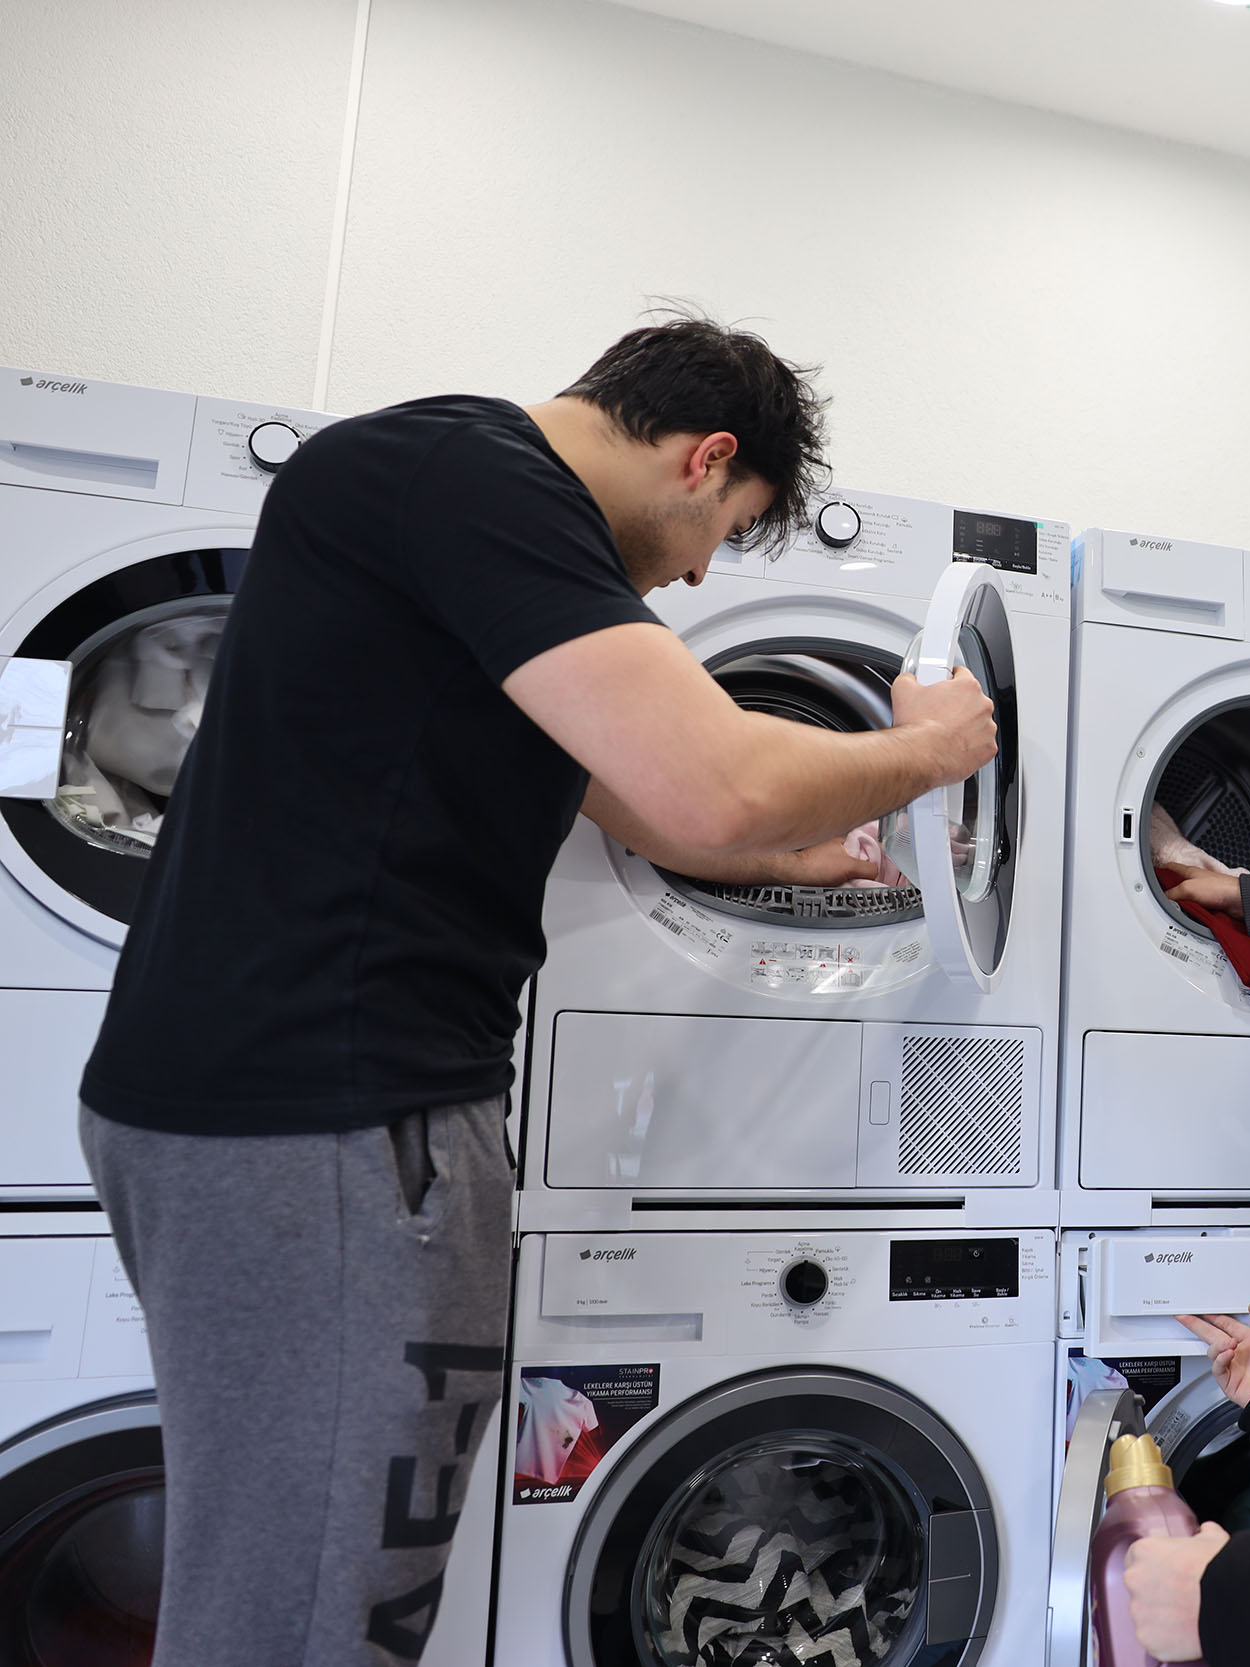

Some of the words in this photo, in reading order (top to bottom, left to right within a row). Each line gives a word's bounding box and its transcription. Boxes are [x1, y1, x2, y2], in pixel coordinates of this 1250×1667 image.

[36, 380, 88, 394] arçelik
[1140, 540, 1172, 552] arçelik
[593, 1248, 637, 1263] arçelik
[1156, 1252, 1193, 1266] arçelik
[532, 1485, 572, 1500] arçelik
